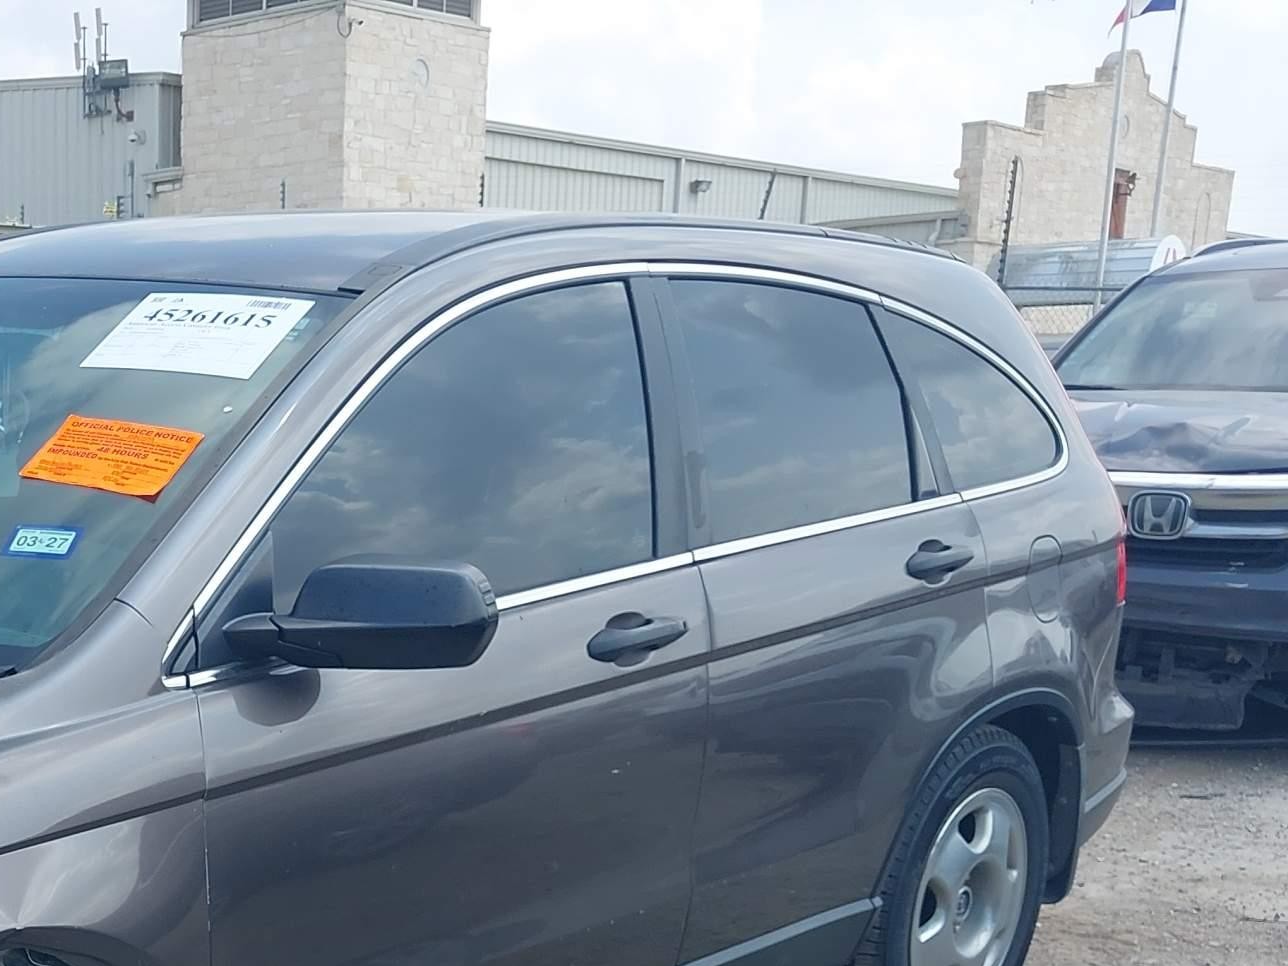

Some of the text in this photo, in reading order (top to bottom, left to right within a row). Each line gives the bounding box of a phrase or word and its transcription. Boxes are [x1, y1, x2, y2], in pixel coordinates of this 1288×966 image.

[143, 307, 277, 329] 45261615
[71, 421, 115, 432] OFFICIAL
[116, 425, 153, 436] POLICE
[155, 431, 194, 444] NOTICE
[47, 447, 98, 460] IMPOUNDED
[112, 447, 150, 460] HOURS
